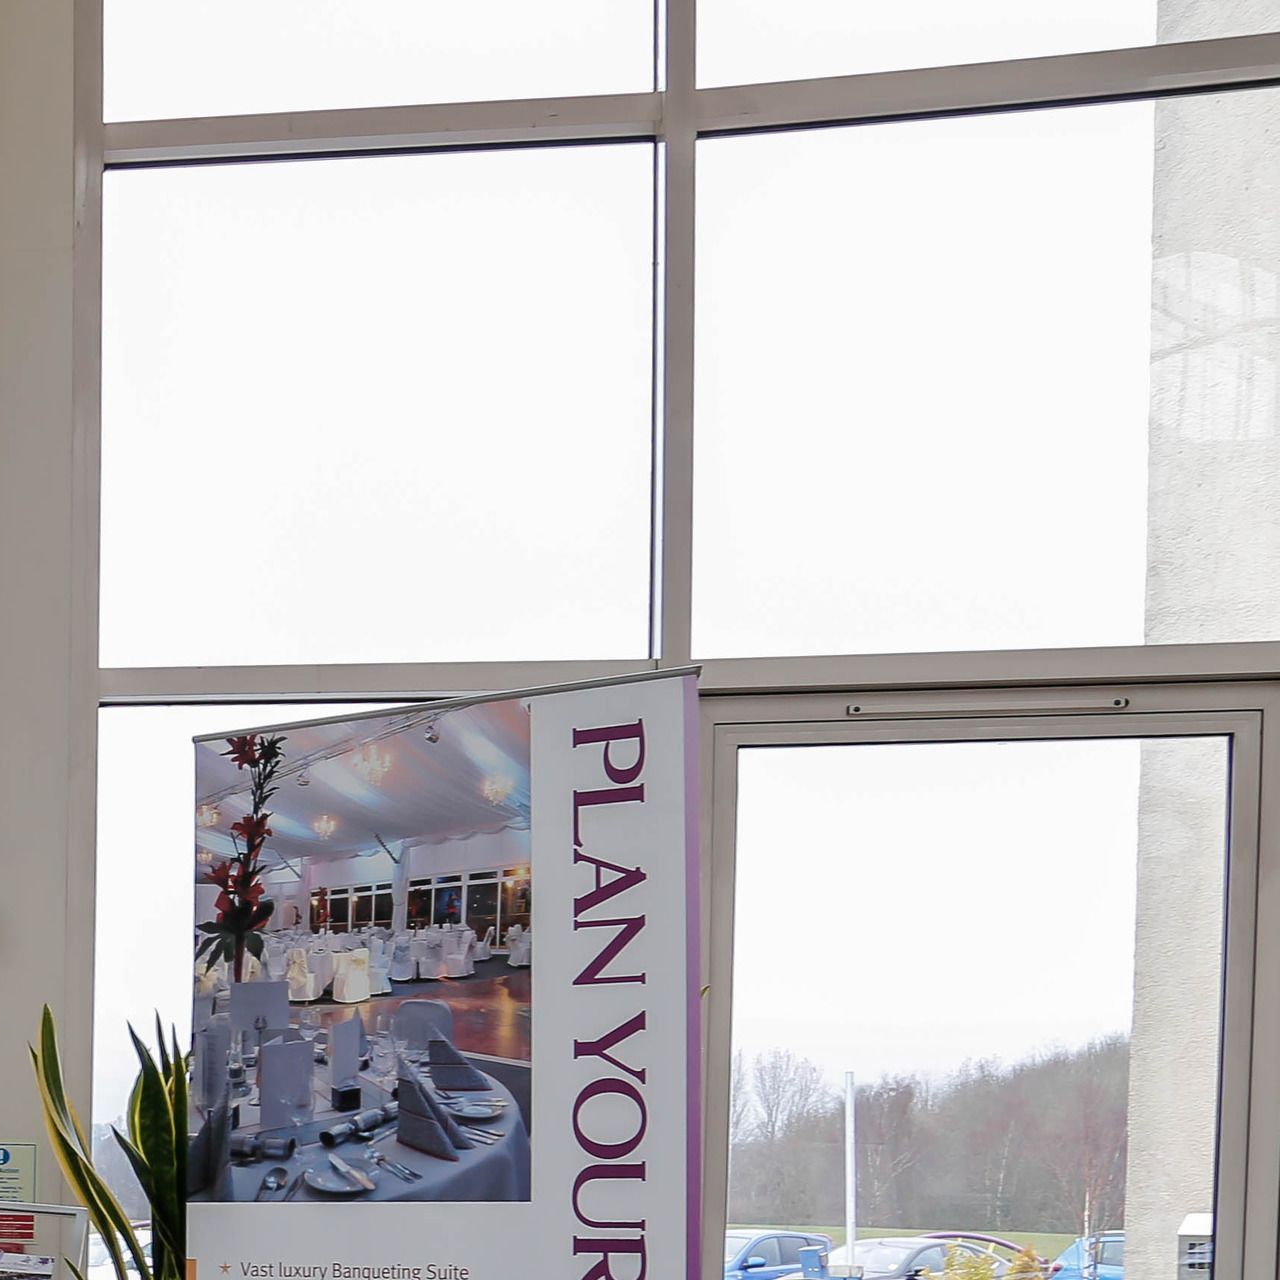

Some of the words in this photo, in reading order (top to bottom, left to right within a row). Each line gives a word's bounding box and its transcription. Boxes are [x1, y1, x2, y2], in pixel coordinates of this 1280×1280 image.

[572, 718, 648, 986] PLAN
[240, 1262, 274, 1278] Vast
[279, 1262, 327, 1280] luxury
[426, 1263, 469, 1280] Suite
